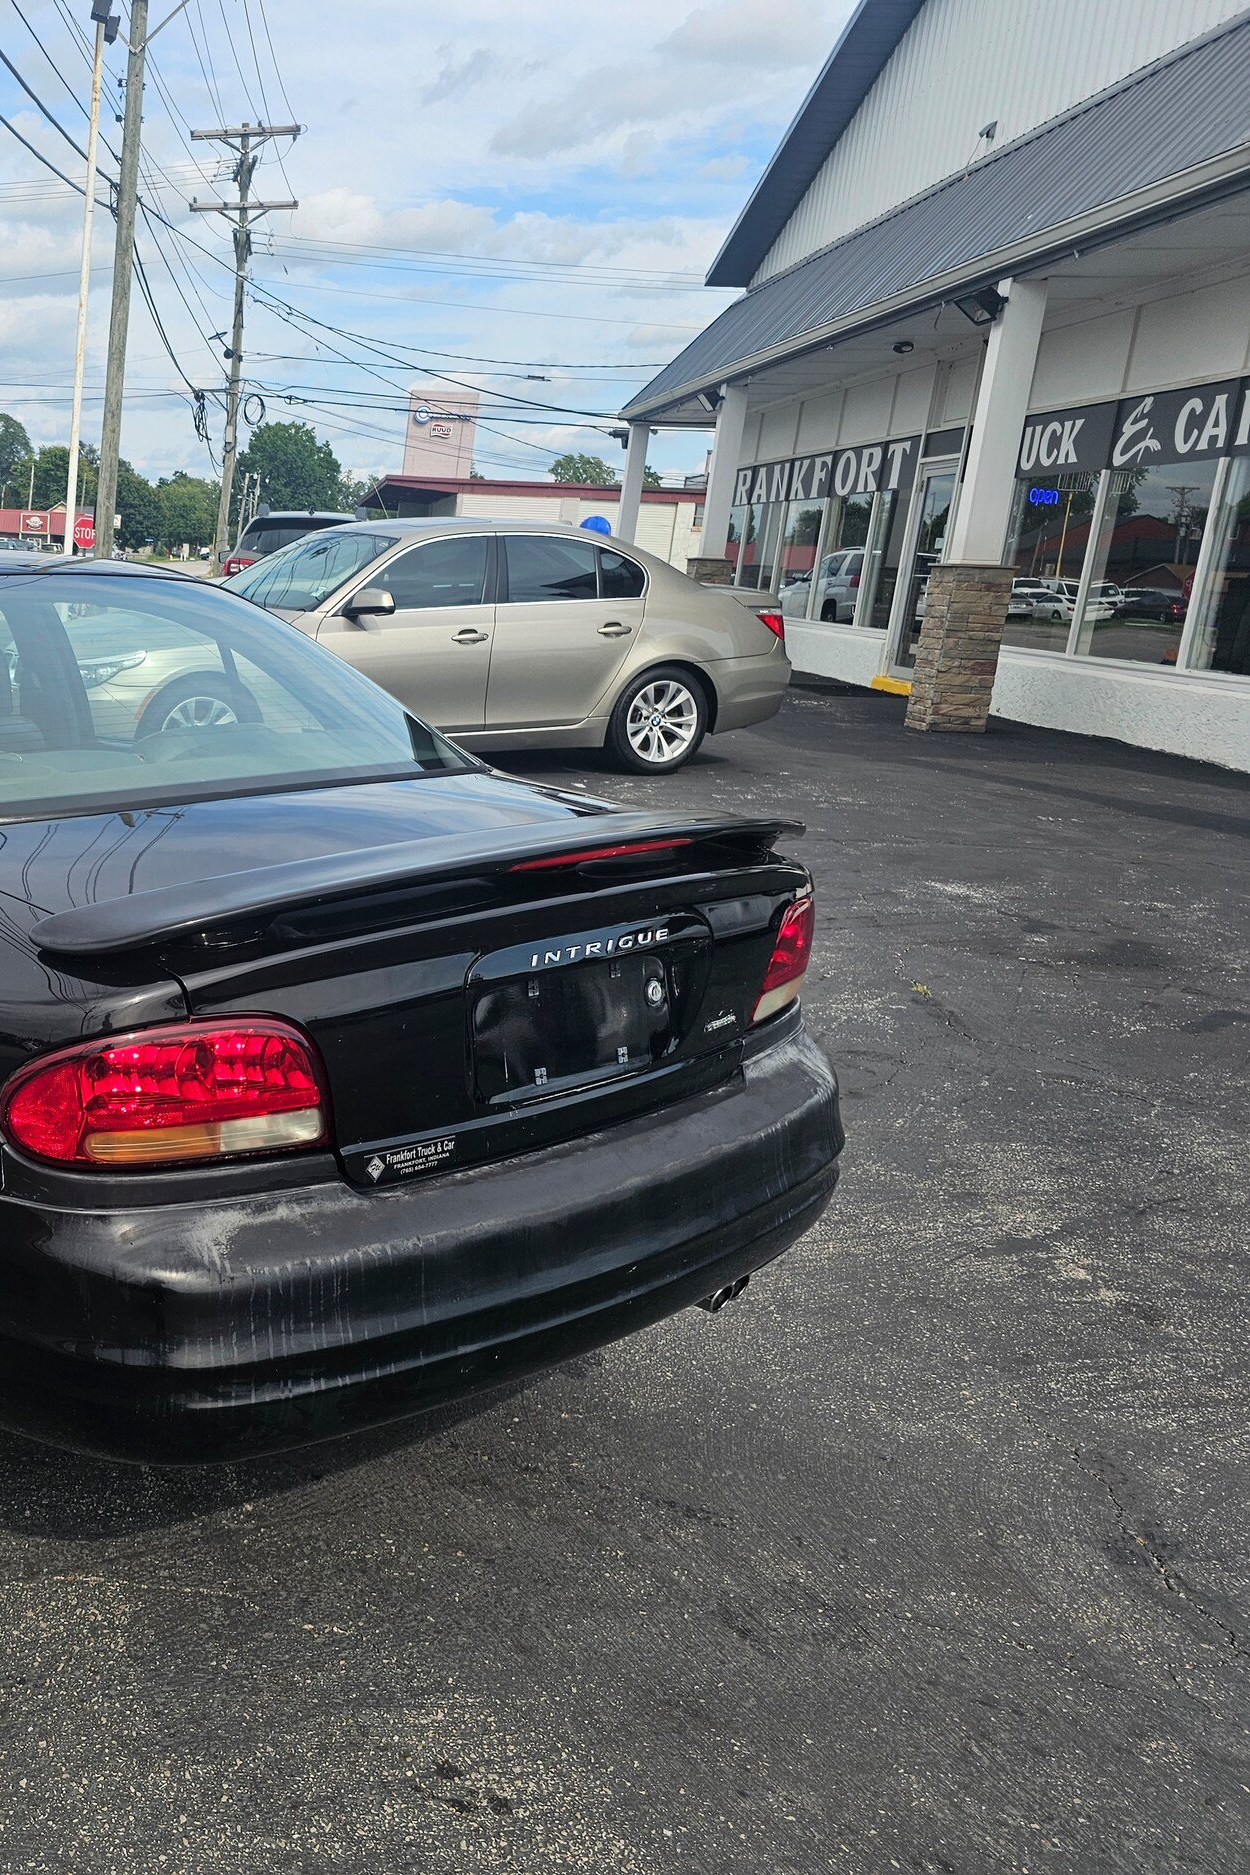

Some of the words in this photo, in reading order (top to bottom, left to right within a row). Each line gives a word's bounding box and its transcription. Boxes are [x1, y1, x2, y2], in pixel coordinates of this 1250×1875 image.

[1020, 418, 1086, 471] UCK
[1112, 397, 1162, 467] &
[734, 441, 912, 506] RANKFORT
[530, 928, 669, 968] INTRIGUE
[386, 1149, 416, 1164] Frankfort
[417, 1144, 436, 1157] Truck
[437, 1142, 442, 1152] &
[443, 1140, 455, 1150] Car
[428, 1152, 449, 1160] INDIANA
